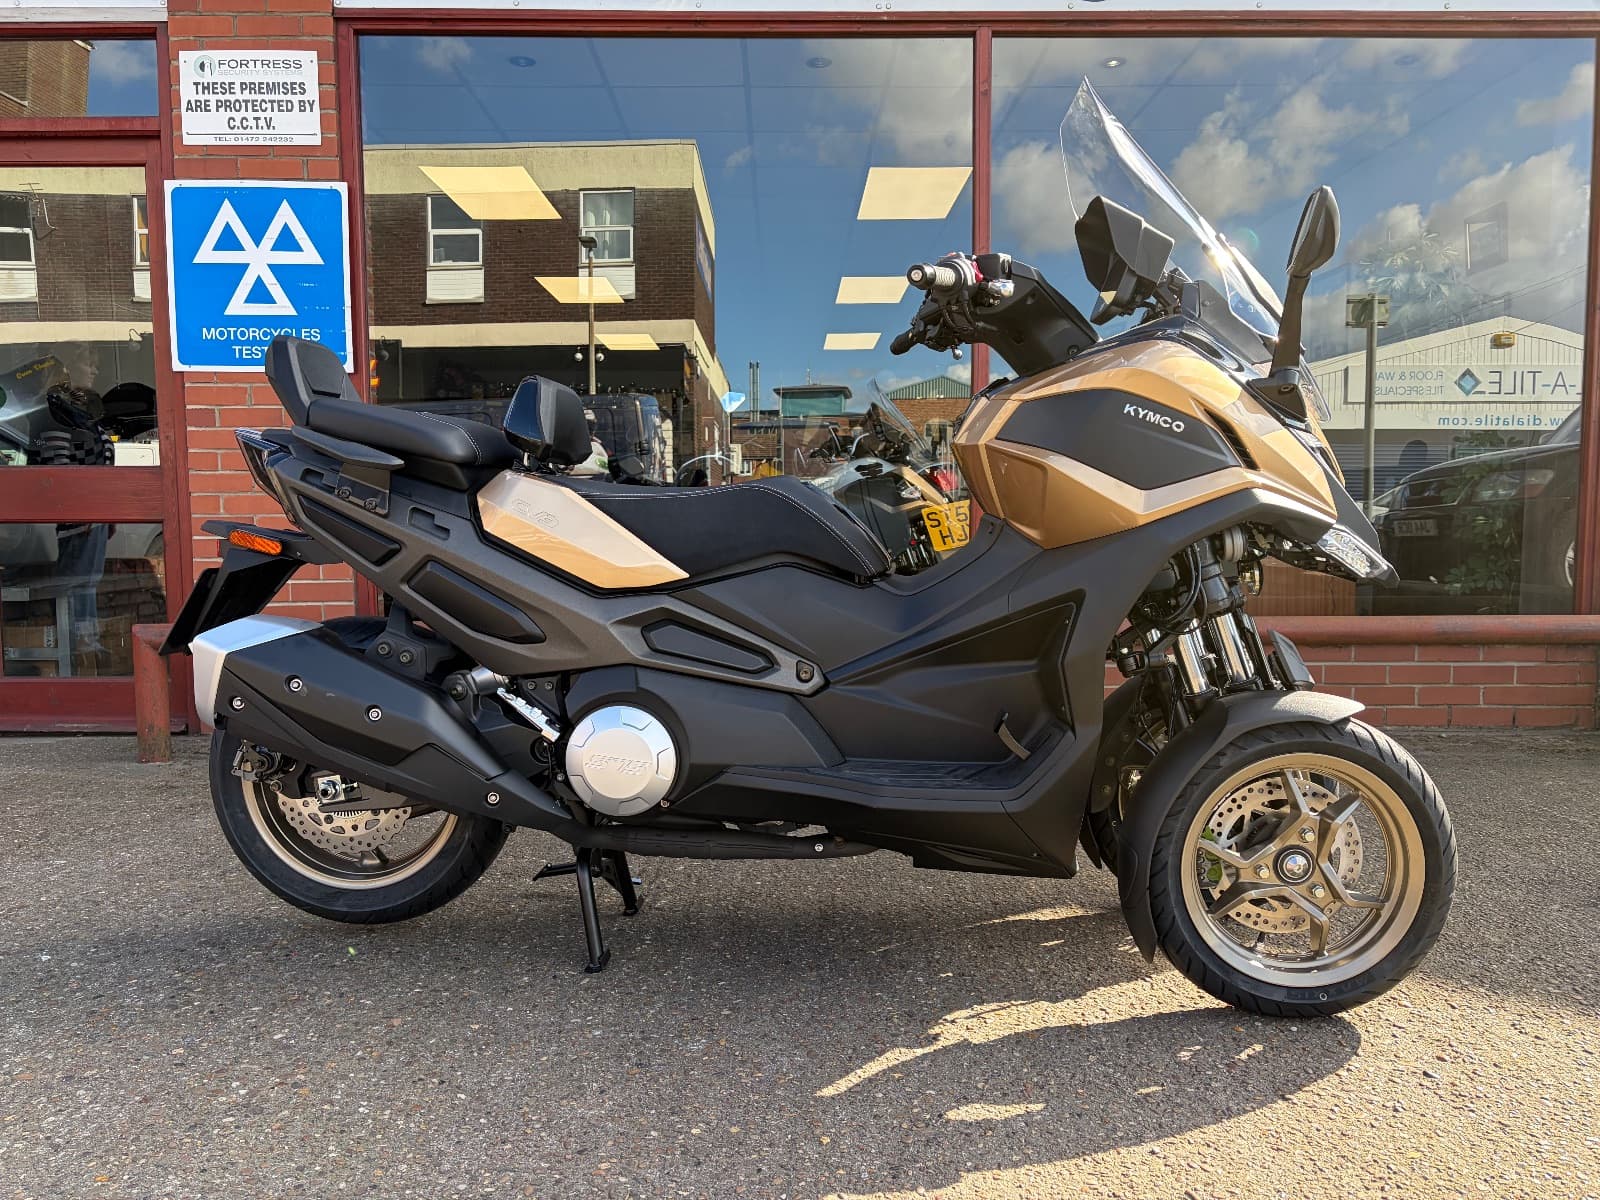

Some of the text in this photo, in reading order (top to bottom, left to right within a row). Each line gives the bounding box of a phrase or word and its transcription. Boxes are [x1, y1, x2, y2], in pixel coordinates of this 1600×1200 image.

[218, 59, 303, 69] FORTRESS
[193, 81, 307, 95] THESE PREMISES
[185, 99, 316, 112] ARE PROTECTED BY
[227, 116, 276, 130] C.C.T.V.
[1123, 403, 1185, 432] KYMCO
